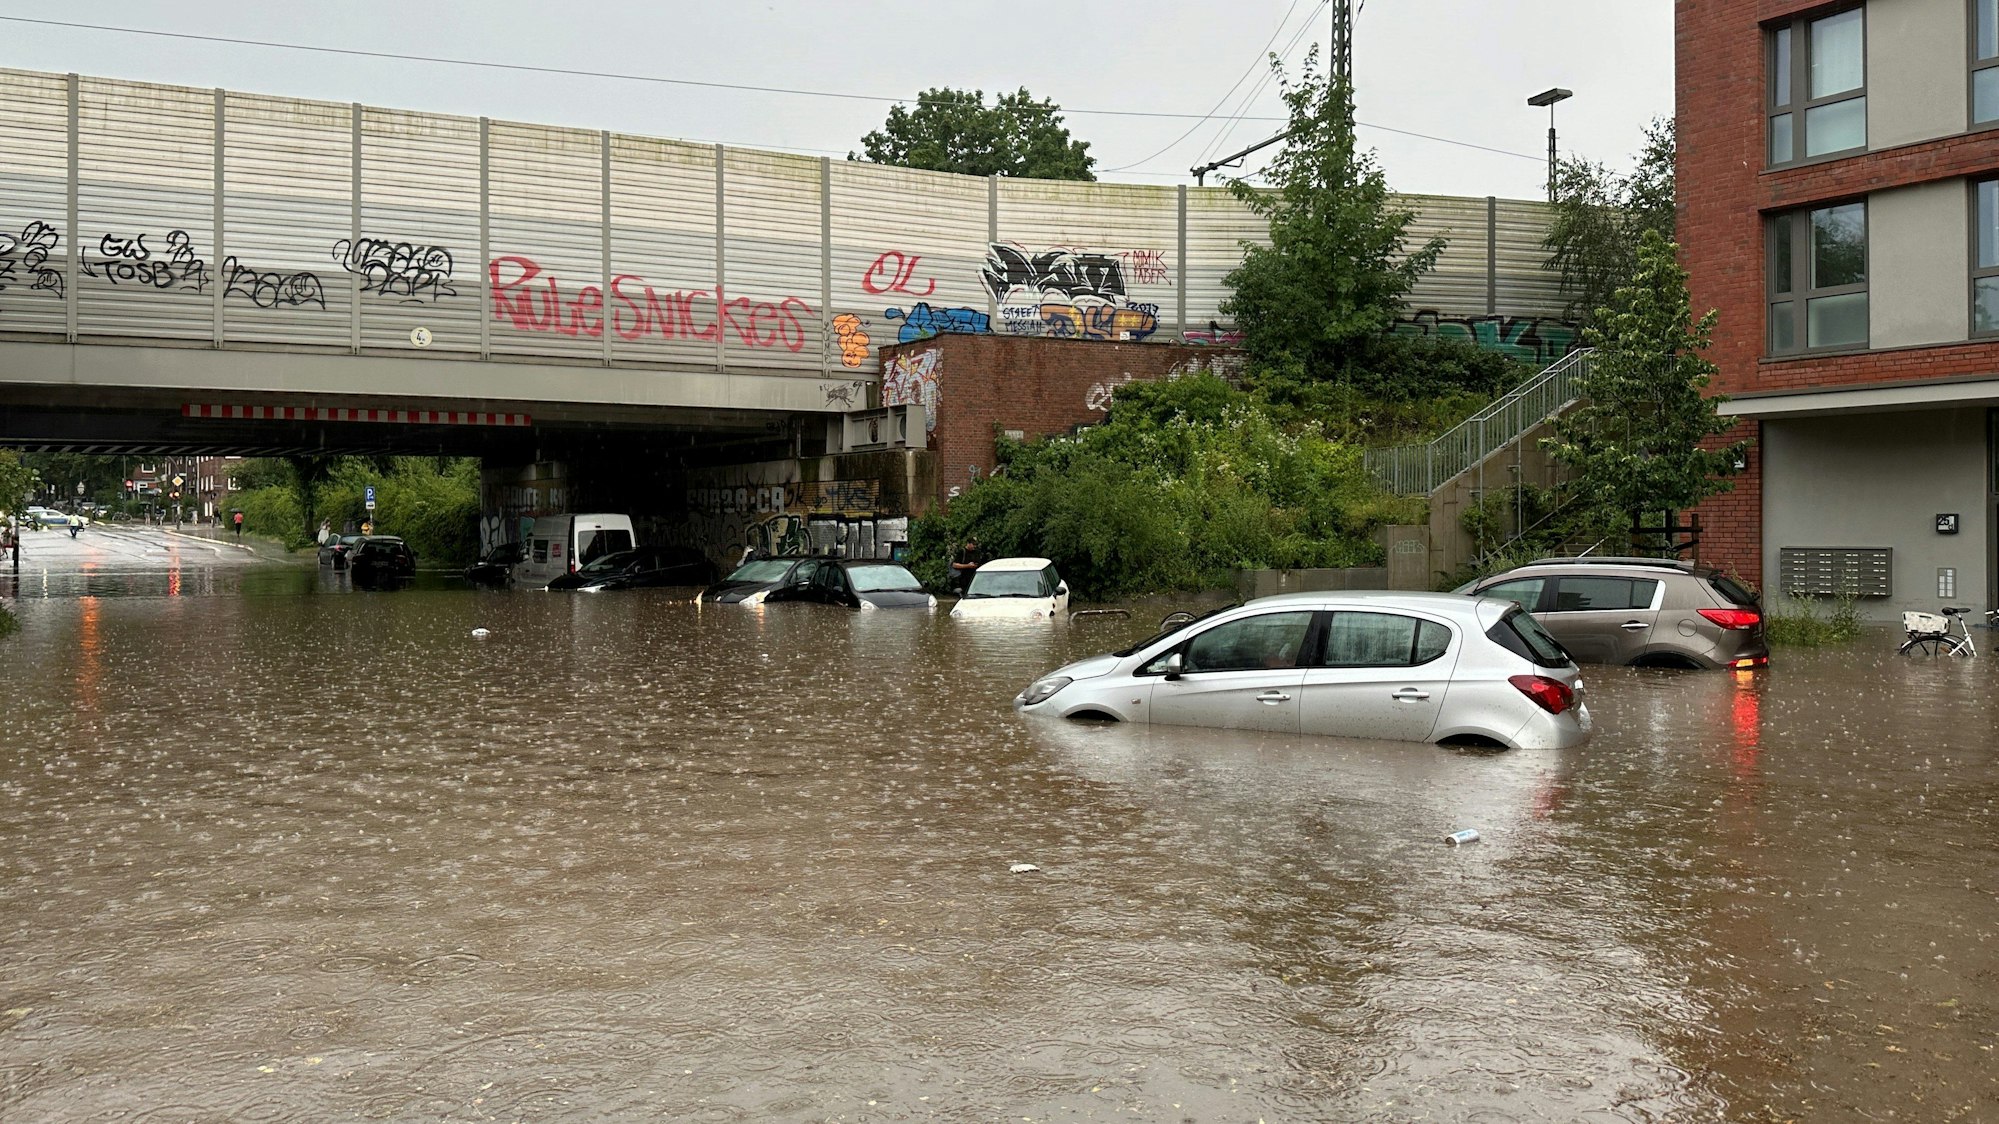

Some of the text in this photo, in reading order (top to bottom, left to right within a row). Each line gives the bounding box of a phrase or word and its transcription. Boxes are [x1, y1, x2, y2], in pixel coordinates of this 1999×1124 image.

[862, 250, 936, 296] OL
[1133, 267, 1172, 286] FABER
[1937, 516, 1949, 526] 25
